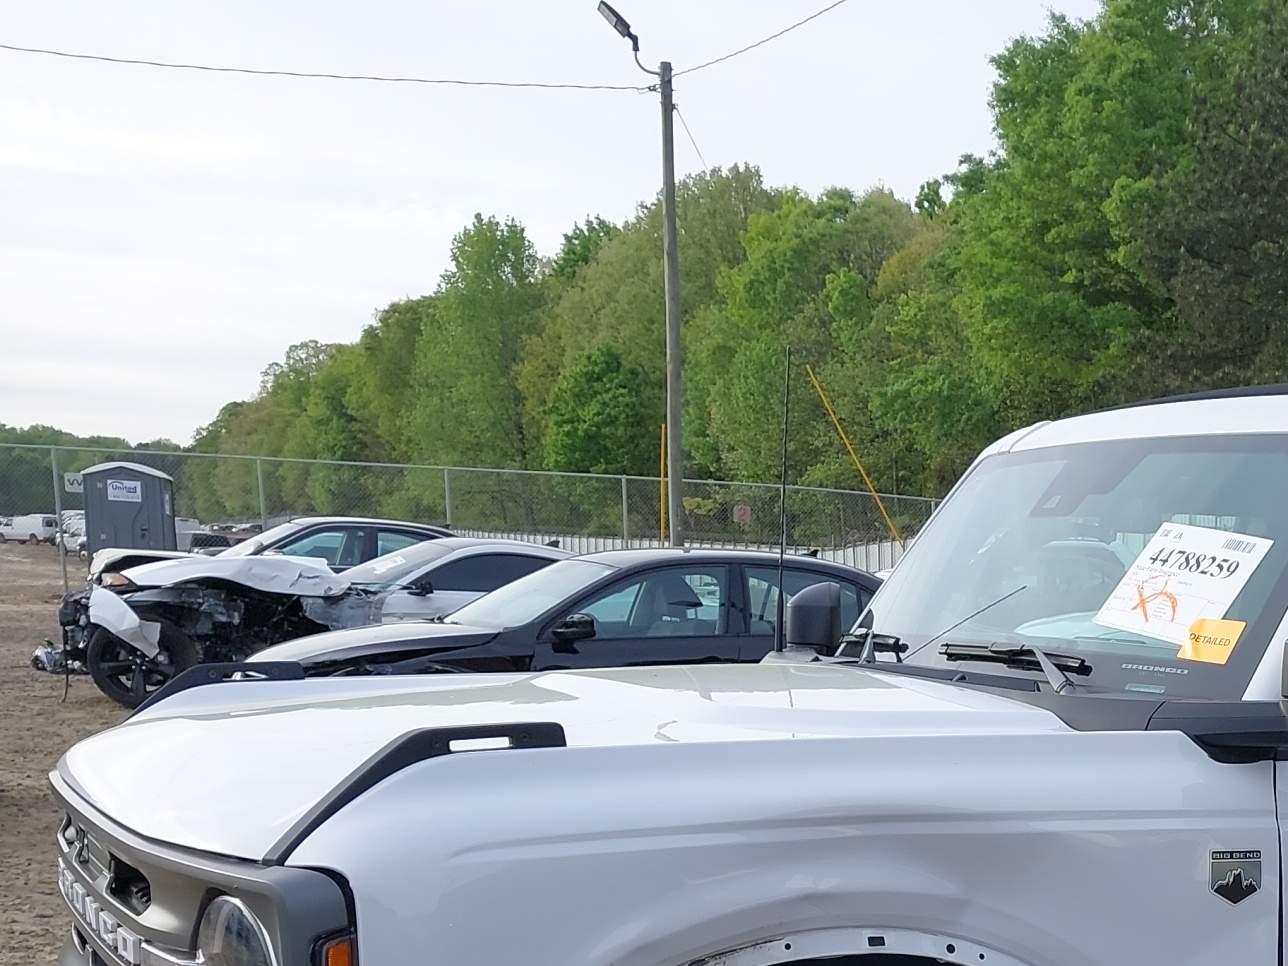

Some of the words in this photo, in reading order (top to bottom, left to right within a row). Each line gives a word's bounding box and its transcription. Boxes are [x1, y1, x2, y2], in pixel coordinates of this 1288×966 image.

[111, 484, 137, 492] United
[1149, 547, 1240, 579] 44788259
[1189, 633, 1231, 647] DETAILED
